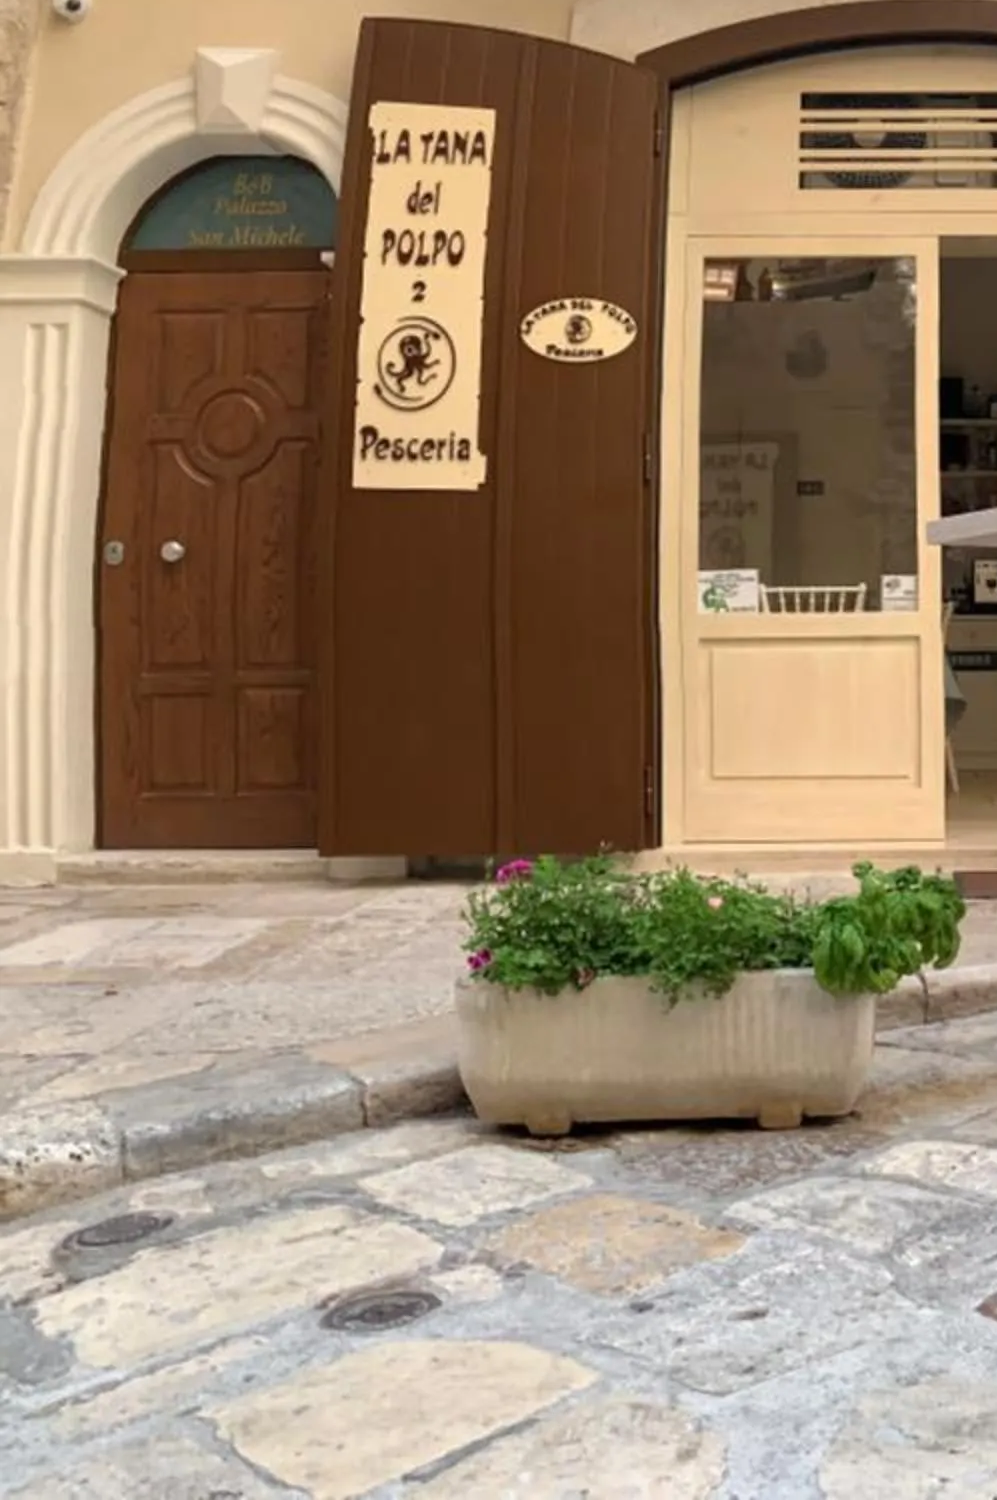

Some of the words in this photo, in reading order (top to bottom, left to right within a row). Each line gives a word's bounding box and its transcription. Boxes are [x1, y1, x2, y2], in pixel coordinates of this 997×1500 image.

[375, 130, 411, 165] LA
[420, 129, 488, 165] TANA
[406, 180, 442, 215] del
[380, 229, 466, 267] POLPO
[411, 280, 427, 302] 2
[359, 426, 471, 462] Pesceria
